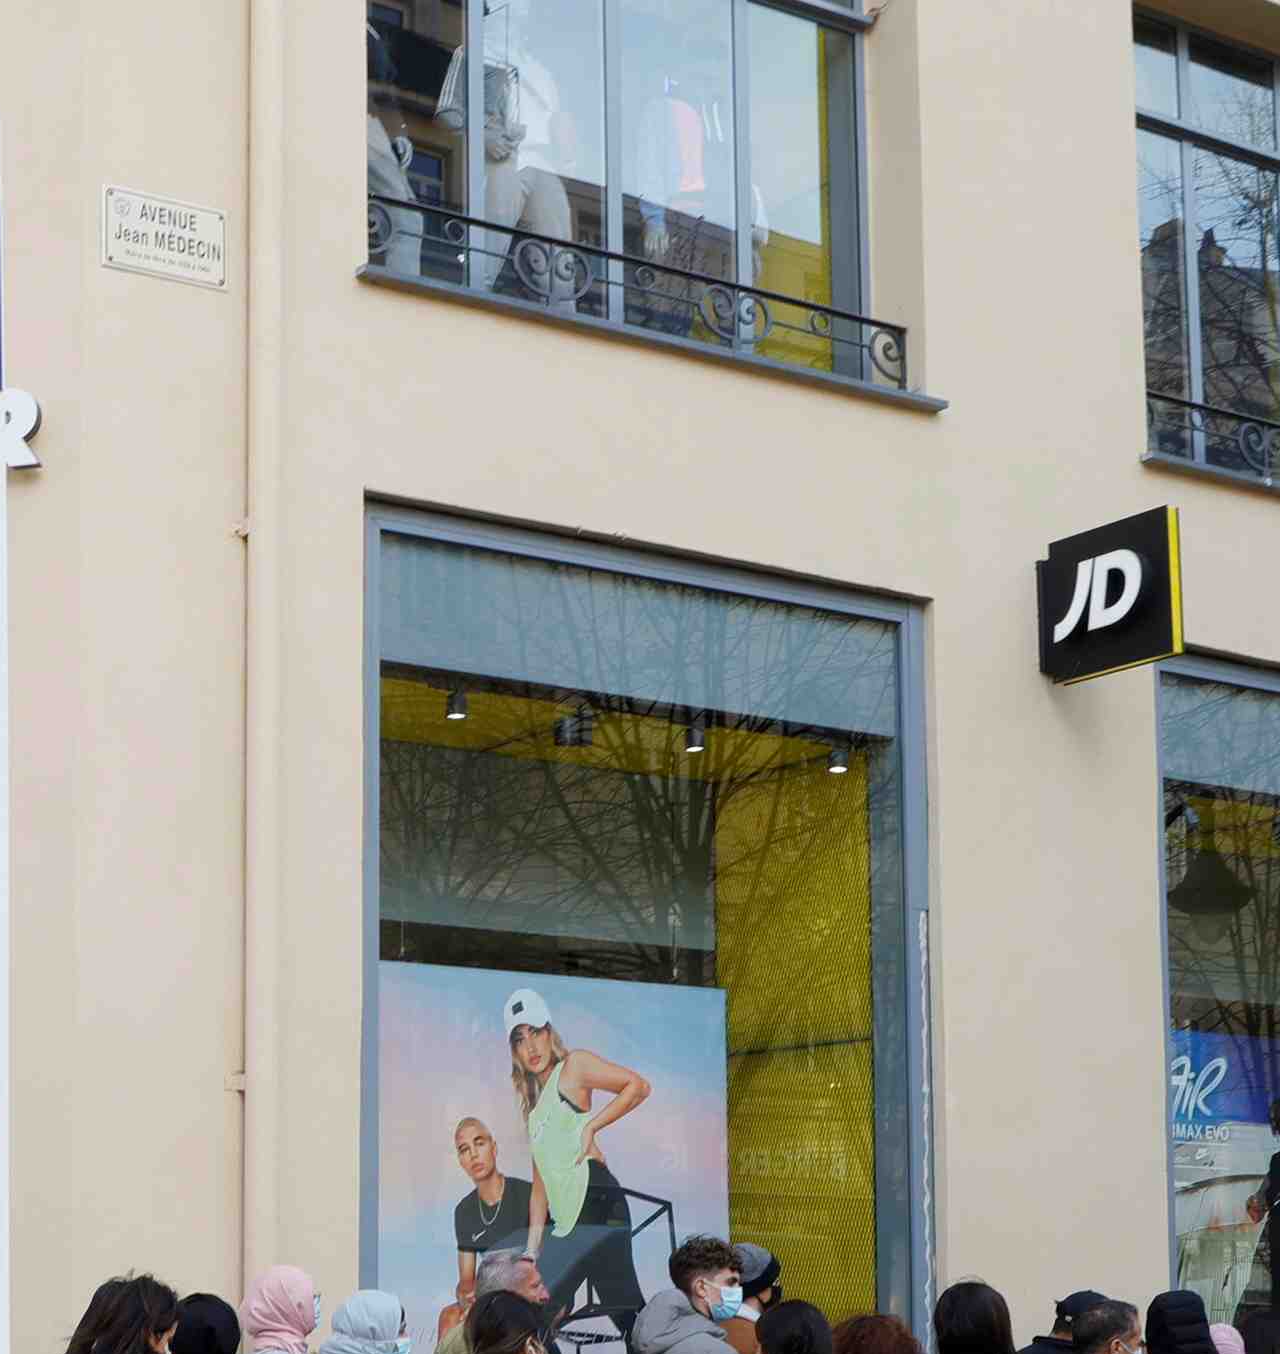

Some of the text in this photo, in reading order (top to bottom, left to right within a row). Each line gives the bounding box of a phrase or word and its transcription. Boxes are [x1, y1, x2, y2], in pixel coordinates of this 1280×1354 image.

[140, 202, 198, 232] AVENUE
[114, 222, 149, 247] Jean
[154, 230, 222, 262] MÉDECIN
[1053, 548, 1143, 644] JD
